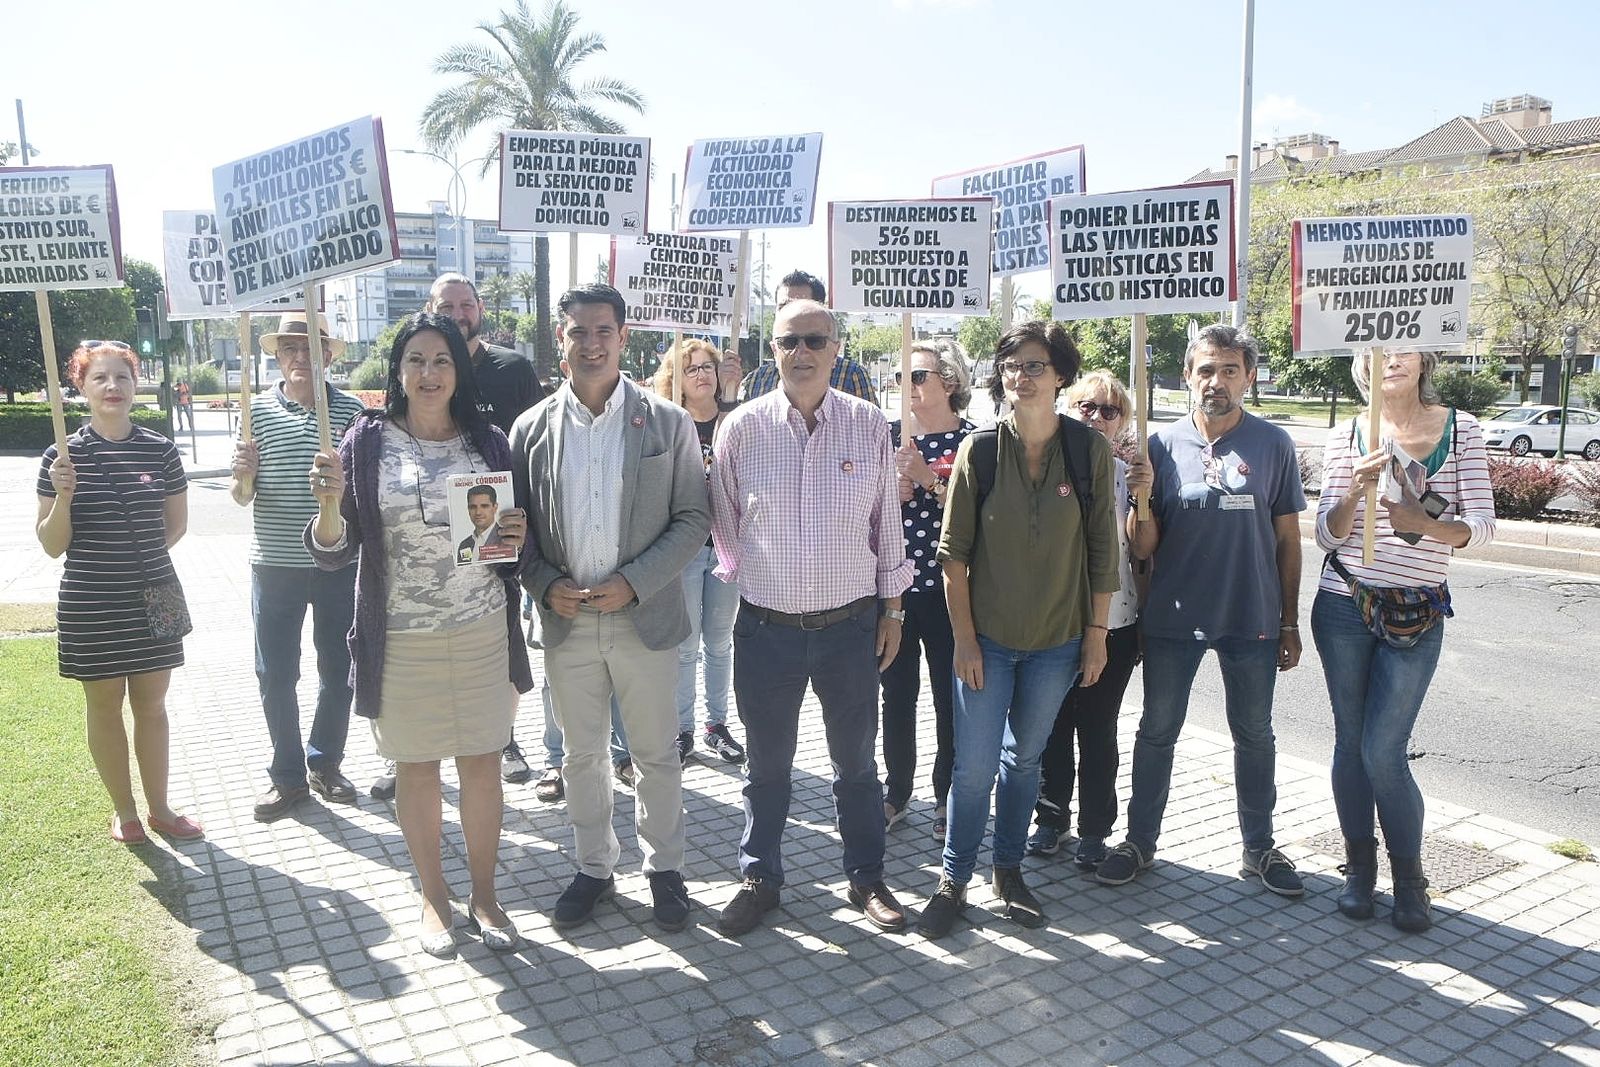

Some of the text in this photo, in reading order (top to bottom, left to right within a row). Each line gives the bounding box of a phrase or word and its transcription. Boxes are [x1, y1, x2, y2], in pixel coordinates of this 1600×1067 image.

[509, 137, 643, 159] EMPRESA PÚBLICA
[703, 137, 806, 157] IMPULSO A LA
[233, 127, 350, 188] AHORRADOS
[513, 155, 637, 176] PARA LA MEJORA
[710, 154, 794, 173] ACTIVIDAD
[224, 149, 367, 218] 2,5 MILLONES €
[515, 173, 633, 193] DEL SERVICIO DE
[707, 171, 792, 190] ECONOMICA
[962, 160, 1048, 196] FACILITAR
[1051, 175, 1074, 195] DE
[59, 196, 82, 215] DE
[86, 194, 100, 214] €
[540, 191, 606, 209] AYUDA A
[709, 189, 785, 208] MEDIANTE
[232, 178, 368, 242] ANUALES EN EL
[535, 208, 610, 227] DOMICILIO
[689, 206, 802, 225] COOPERATIVAS
[846, 206, 977, 223] DESTINAREMOS EL
[1060, 199, 1221, 230] PONER LÍMITE A
[56, 219, 95, 238] SUR,
[878, 226, 941, 246] 5% DEL
[1306, 217, 1467, 242] HEMOS AUMENTADO
[228, 227, 298, 271] SERVICIO
[710, 238, 733, 253] DEL
[1061, 224, 1218, 254] LAS VIVIENDAS
[37, 241, 109, 260] LEVANTE
[650, 247, 719, 267] CENTRO DE
[851, 249, 969, 266] PRESUPUESTO A
[1342, 241, 1434, 263] AYUDAS DE
[233, 230, 383, 296] DE ALUMBRADO
[643, 262, 723, 282] EMERGENCIA
[1065, 250, 1214, 279] TURÍSTICAS EN
[852, 268, 968, 288] POLITICAS DE
[1306, 261, 1466, 288] EMERGENCIA SOCIAL
[629, 276, 736, 298] HABITACIONAL Y
[1056, 273, 1225, 303] CASCO HISTÓRICO
[643, 292, 719, 311] DEFENSA DE
[863, 289, 954, 309] IGUALDAD
[1318, 286, 1454, 311] Y FAMILIARES UN
[1344, 310, 1421, 342] 250%
